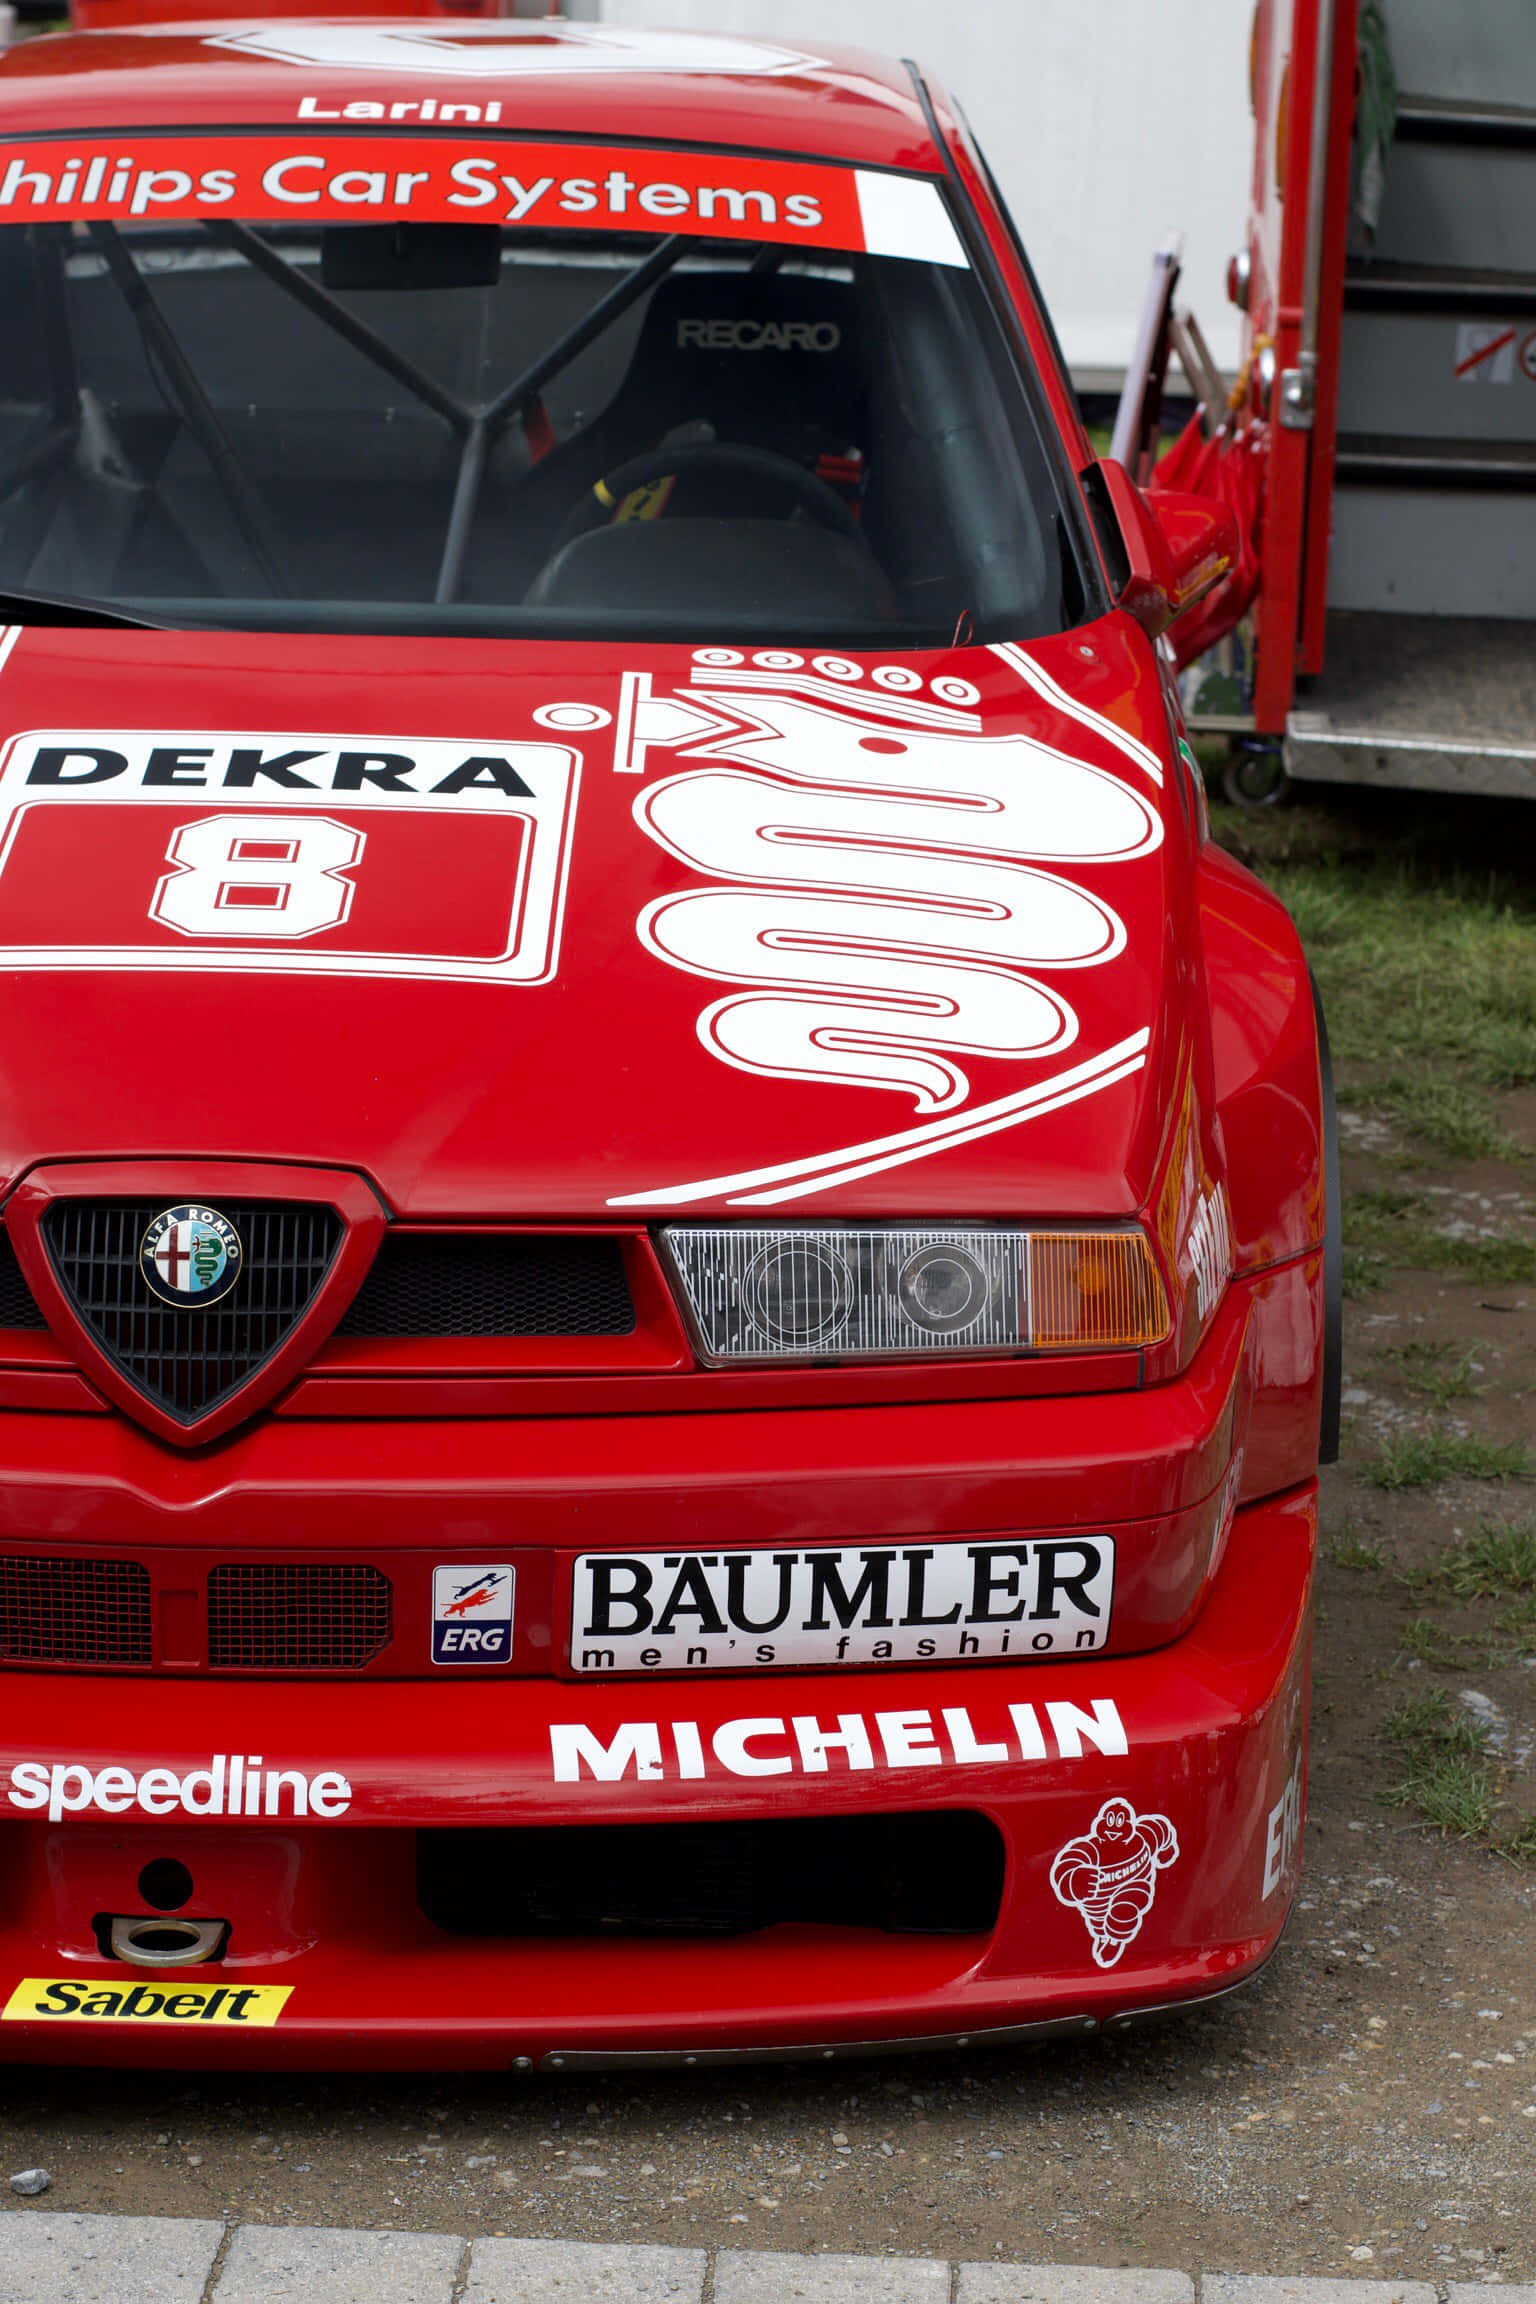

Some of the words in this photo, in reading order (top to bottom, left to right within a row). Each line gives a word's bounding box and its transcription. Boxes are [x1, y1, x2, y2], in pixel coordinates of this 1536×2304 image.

[297, 97, 503, 123] Larini
[0, 156, 237, 214] hilips
[261, 155, 430, 205] Car
[446, 157, 824, 228] Systems
[676, 319, 841, 352] RECARO
[25, 747, 536, 798] DEKRA
[147, 813, 367, 939] 8
[143, 1213, 179, 1258] ALFA
[188, 1208, 239, 1259] ROMEO
[583, 1541, 1102, 1637] BÄUMLER
[440, 1628, 505, 1652] ERG
[835, 1629, 1097, 1660] fashion
[549, 1698, 1129, 1782] MICHELIN
[8, 1754, 353, 1823] speedline
[35, 1982, 262, 2021] Sabelt
